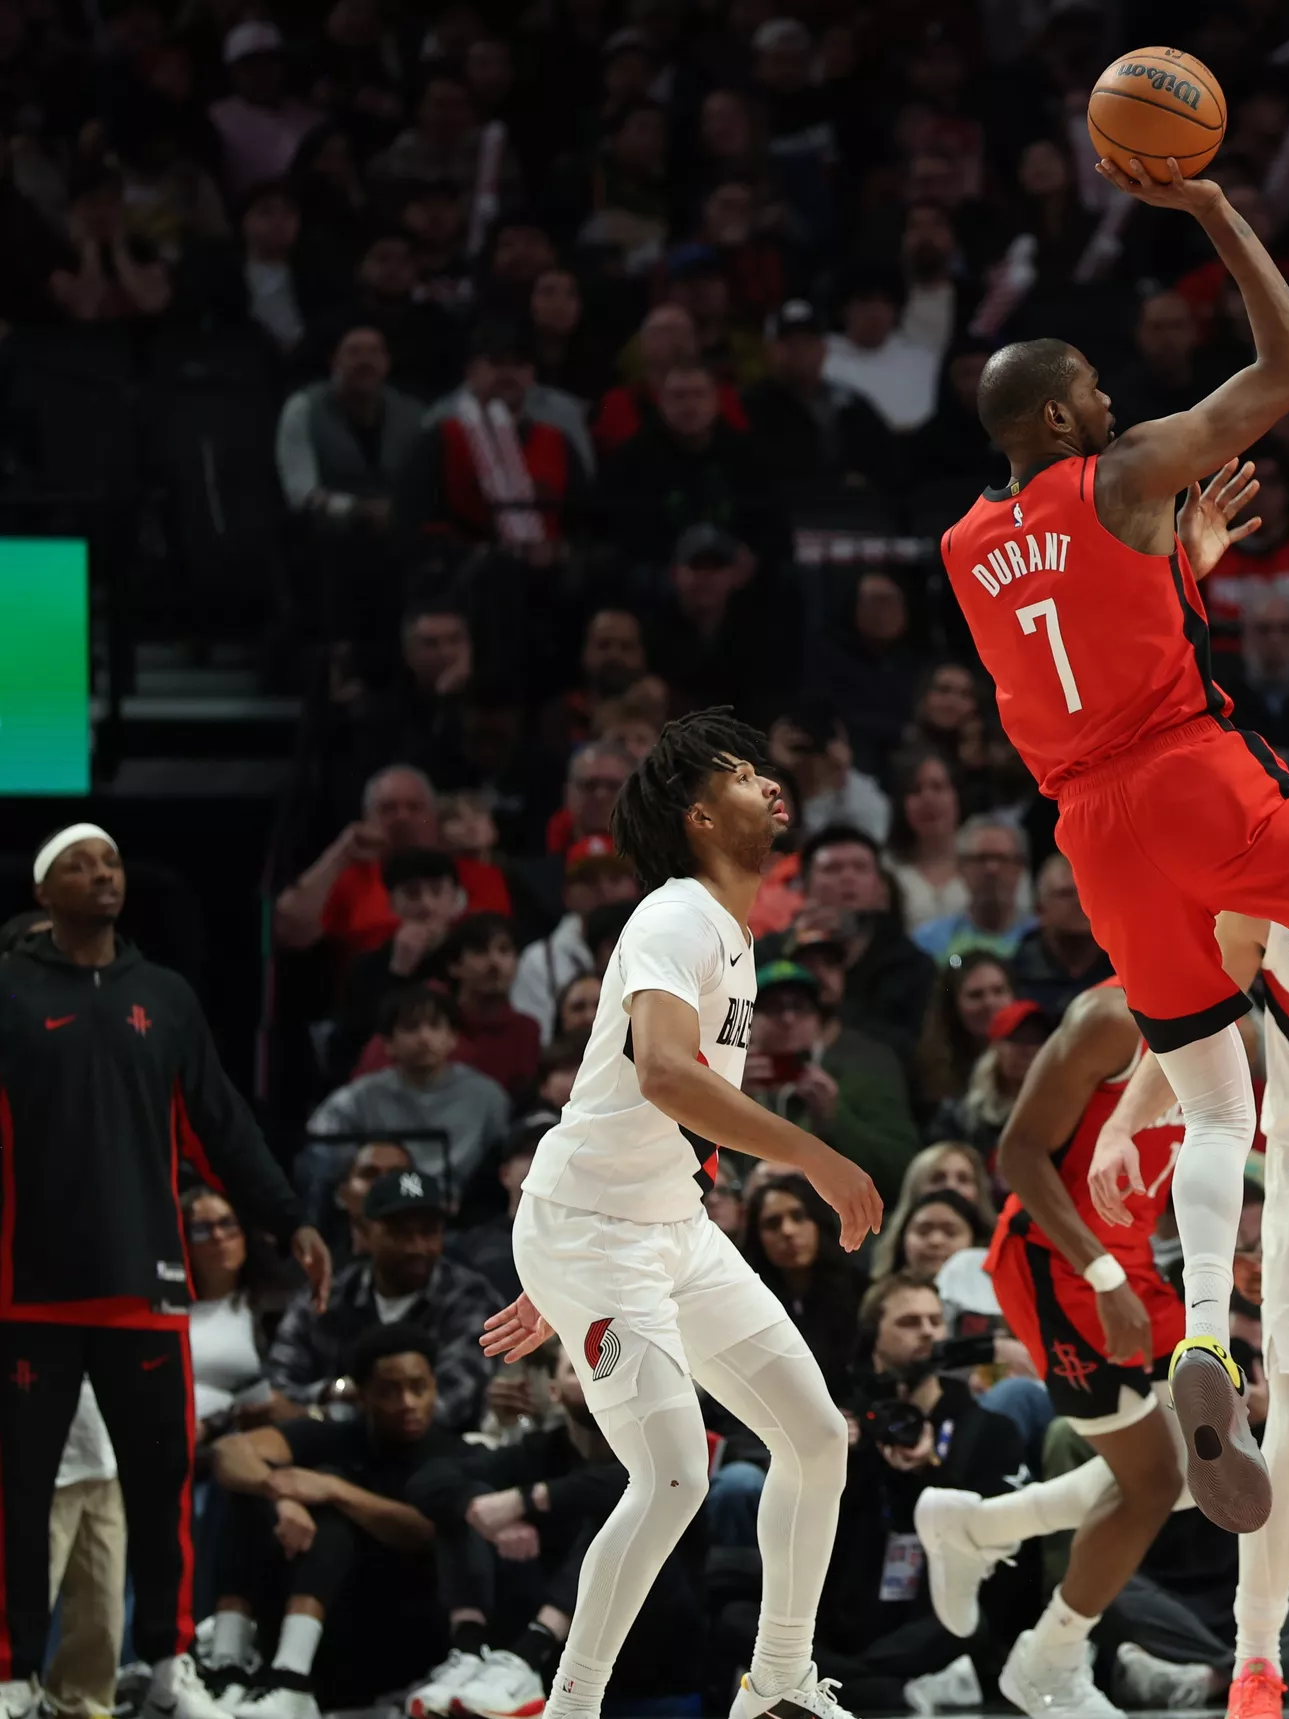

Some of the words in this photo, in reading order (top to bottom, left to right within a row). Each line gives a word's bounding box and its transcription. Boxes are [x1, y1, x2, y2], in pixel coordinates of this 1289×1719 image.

[1117, 63, 1201, 111] Wilson
[971, 531, 1071, 598] DURANT
[1015, 597, 1083, 714] 7
